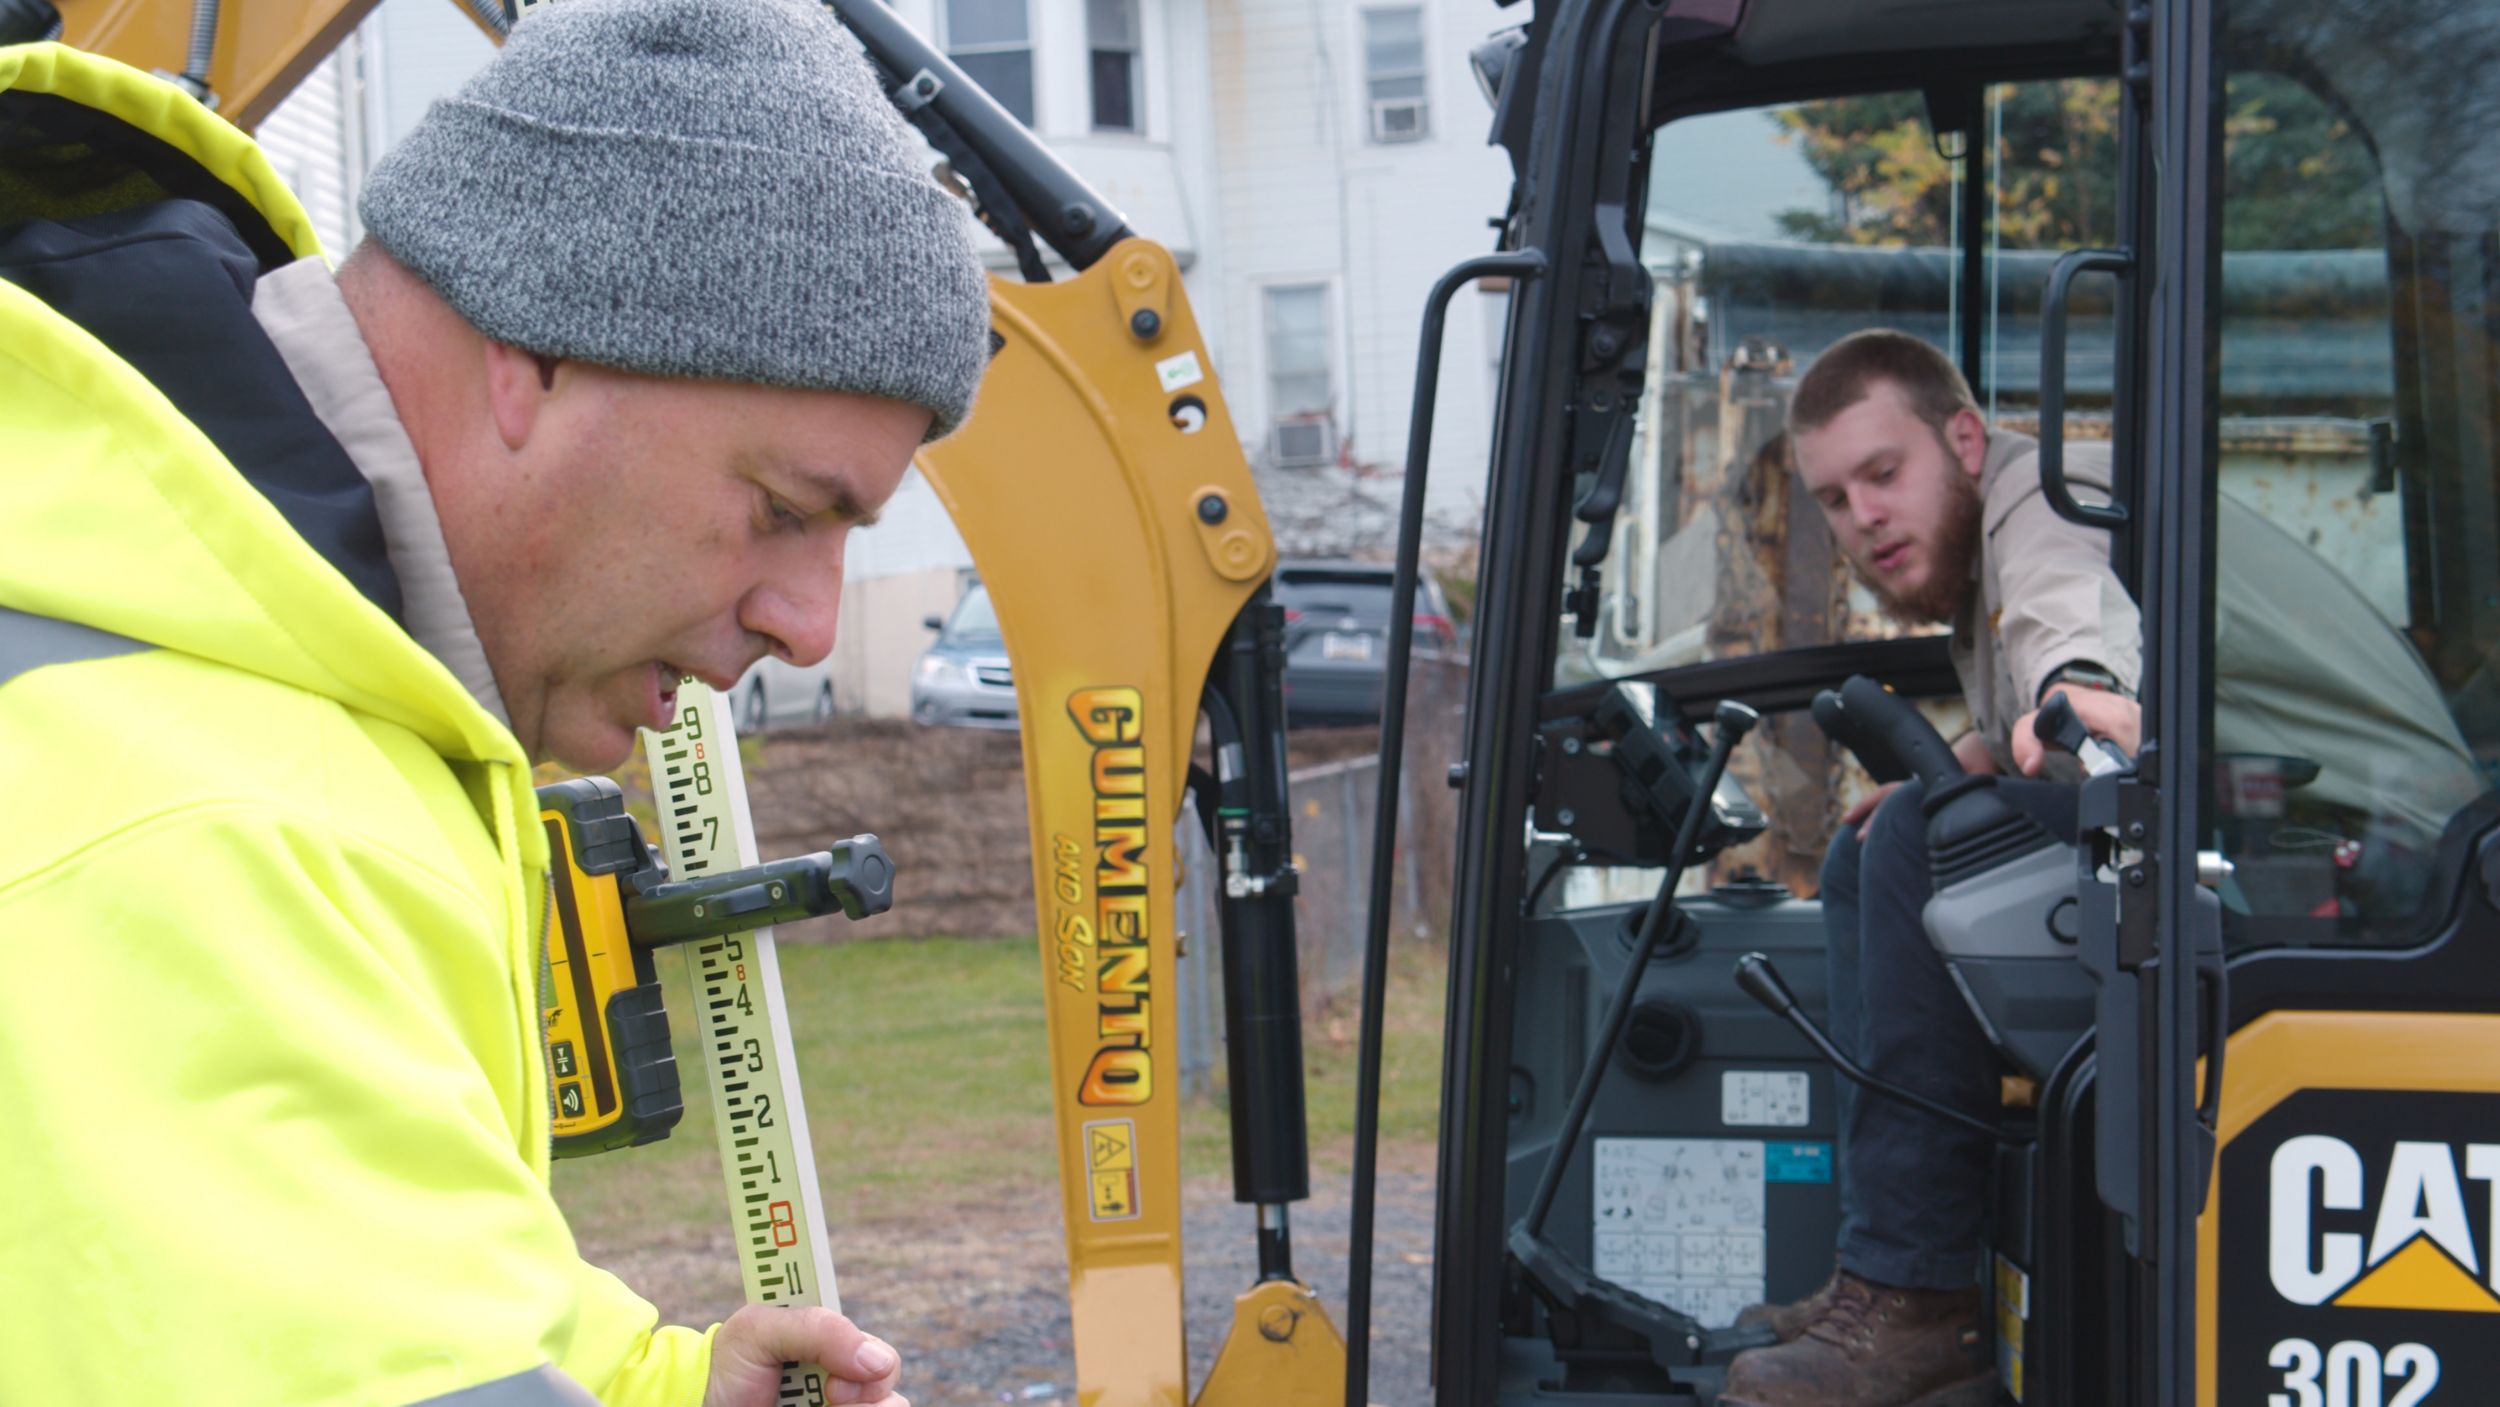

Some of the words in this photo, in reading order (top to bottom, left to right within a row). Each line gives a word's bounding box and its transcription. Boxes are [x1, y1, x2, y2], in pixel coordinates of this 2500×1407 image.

[683, 706, 702, 740] 9
[695, 743, 704, 759] 8
[693, 762, 712, 795] 8
[703, 816, 718, 851] 7
[1066, 685, 1153, 1106] GUIMENTO
[724, 934, 743, 962] 5
[736, 964, 746, 981] 8
[736, 983, 754, 1016] 4
[744, 1038, 763, 1073] 3
[754, 1094, 774, 1128] 2
[767, 1150, 781, 1183] 1
[769, 1200, 798, 1247] 8
[785, 1261, 803, 1296] 11
[2268, 1338, 2440, 1407] 302
[804, 1373, 824, 1407] 9
